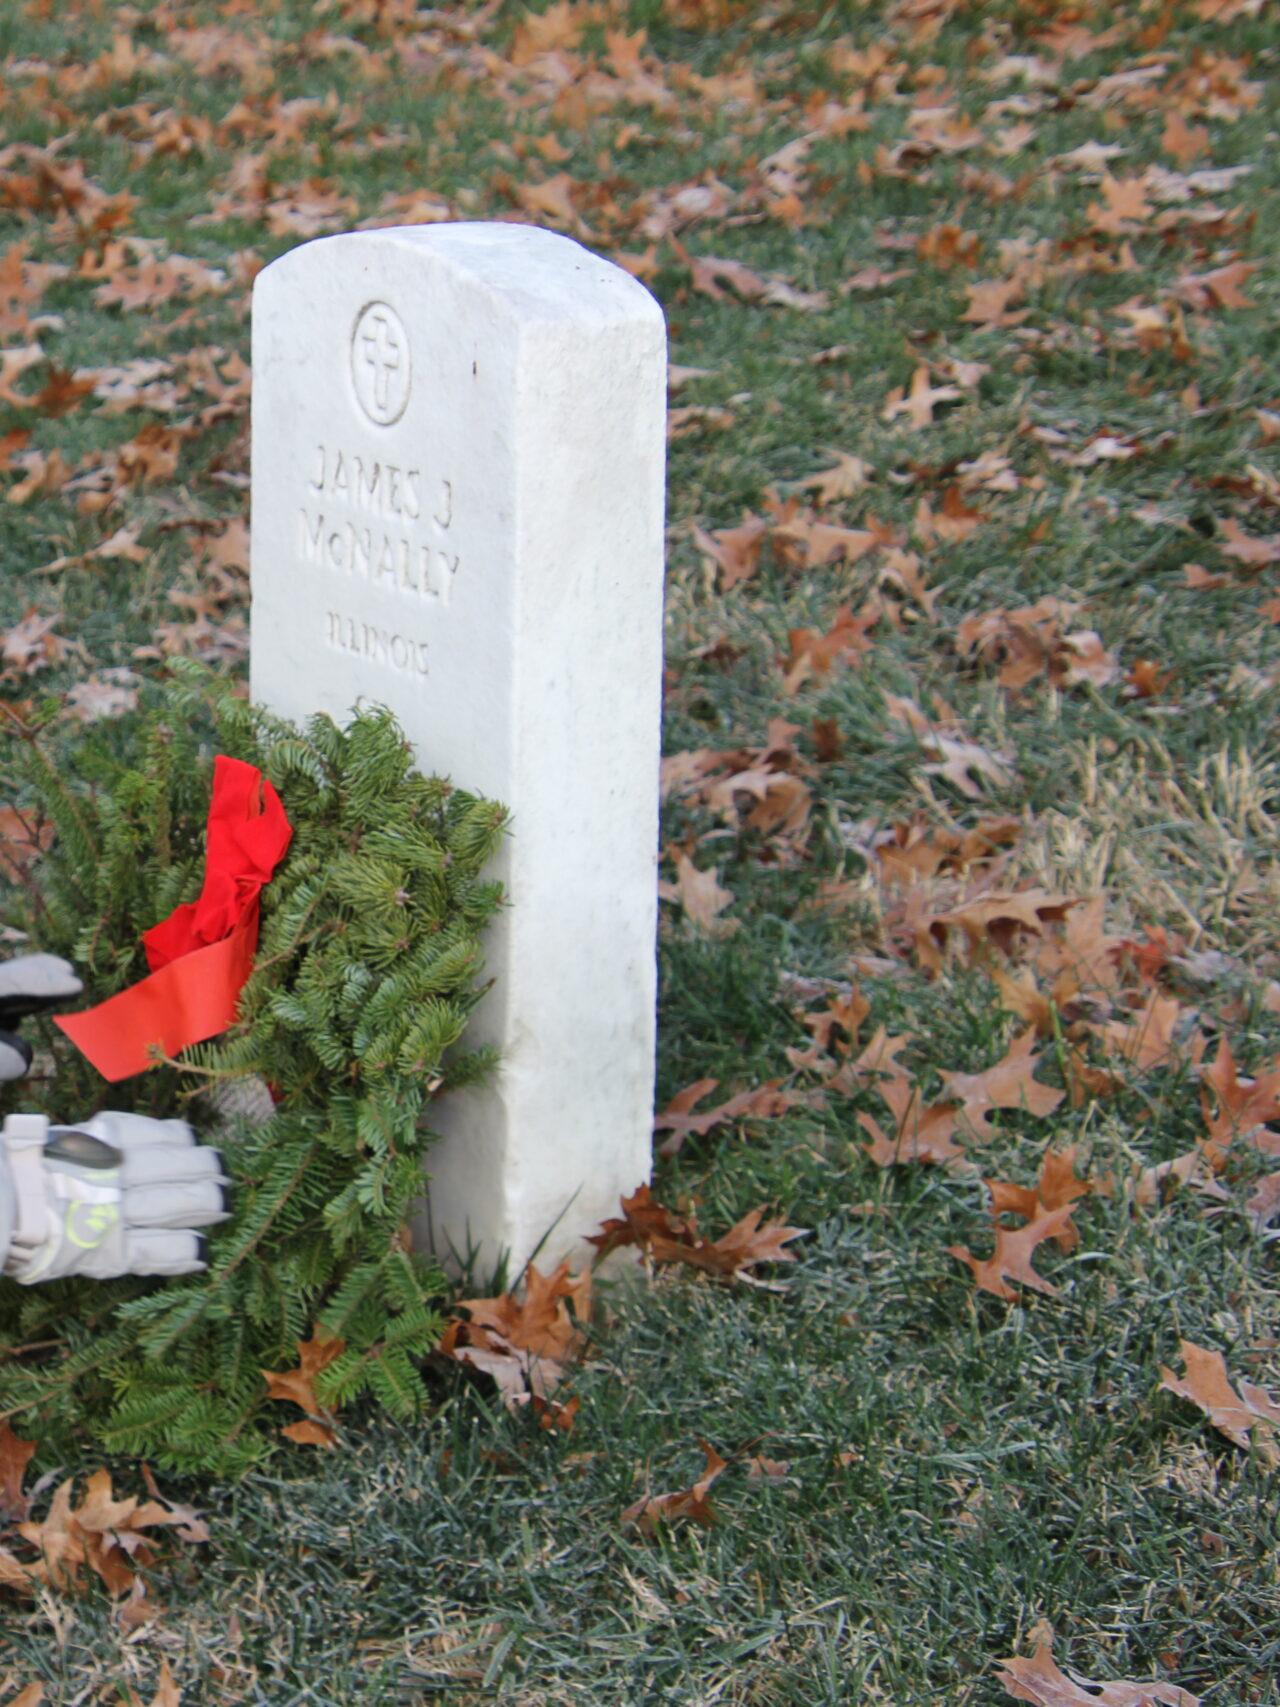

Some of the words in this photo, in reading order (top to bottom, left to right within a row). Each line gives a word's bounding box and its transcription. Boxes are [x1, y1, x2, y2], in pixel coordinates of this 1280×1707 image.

[309, 444, 421, 520] JAMES
[433, 479, 453, 530] J
[326, 611, 429, 677] ILLINOIS
